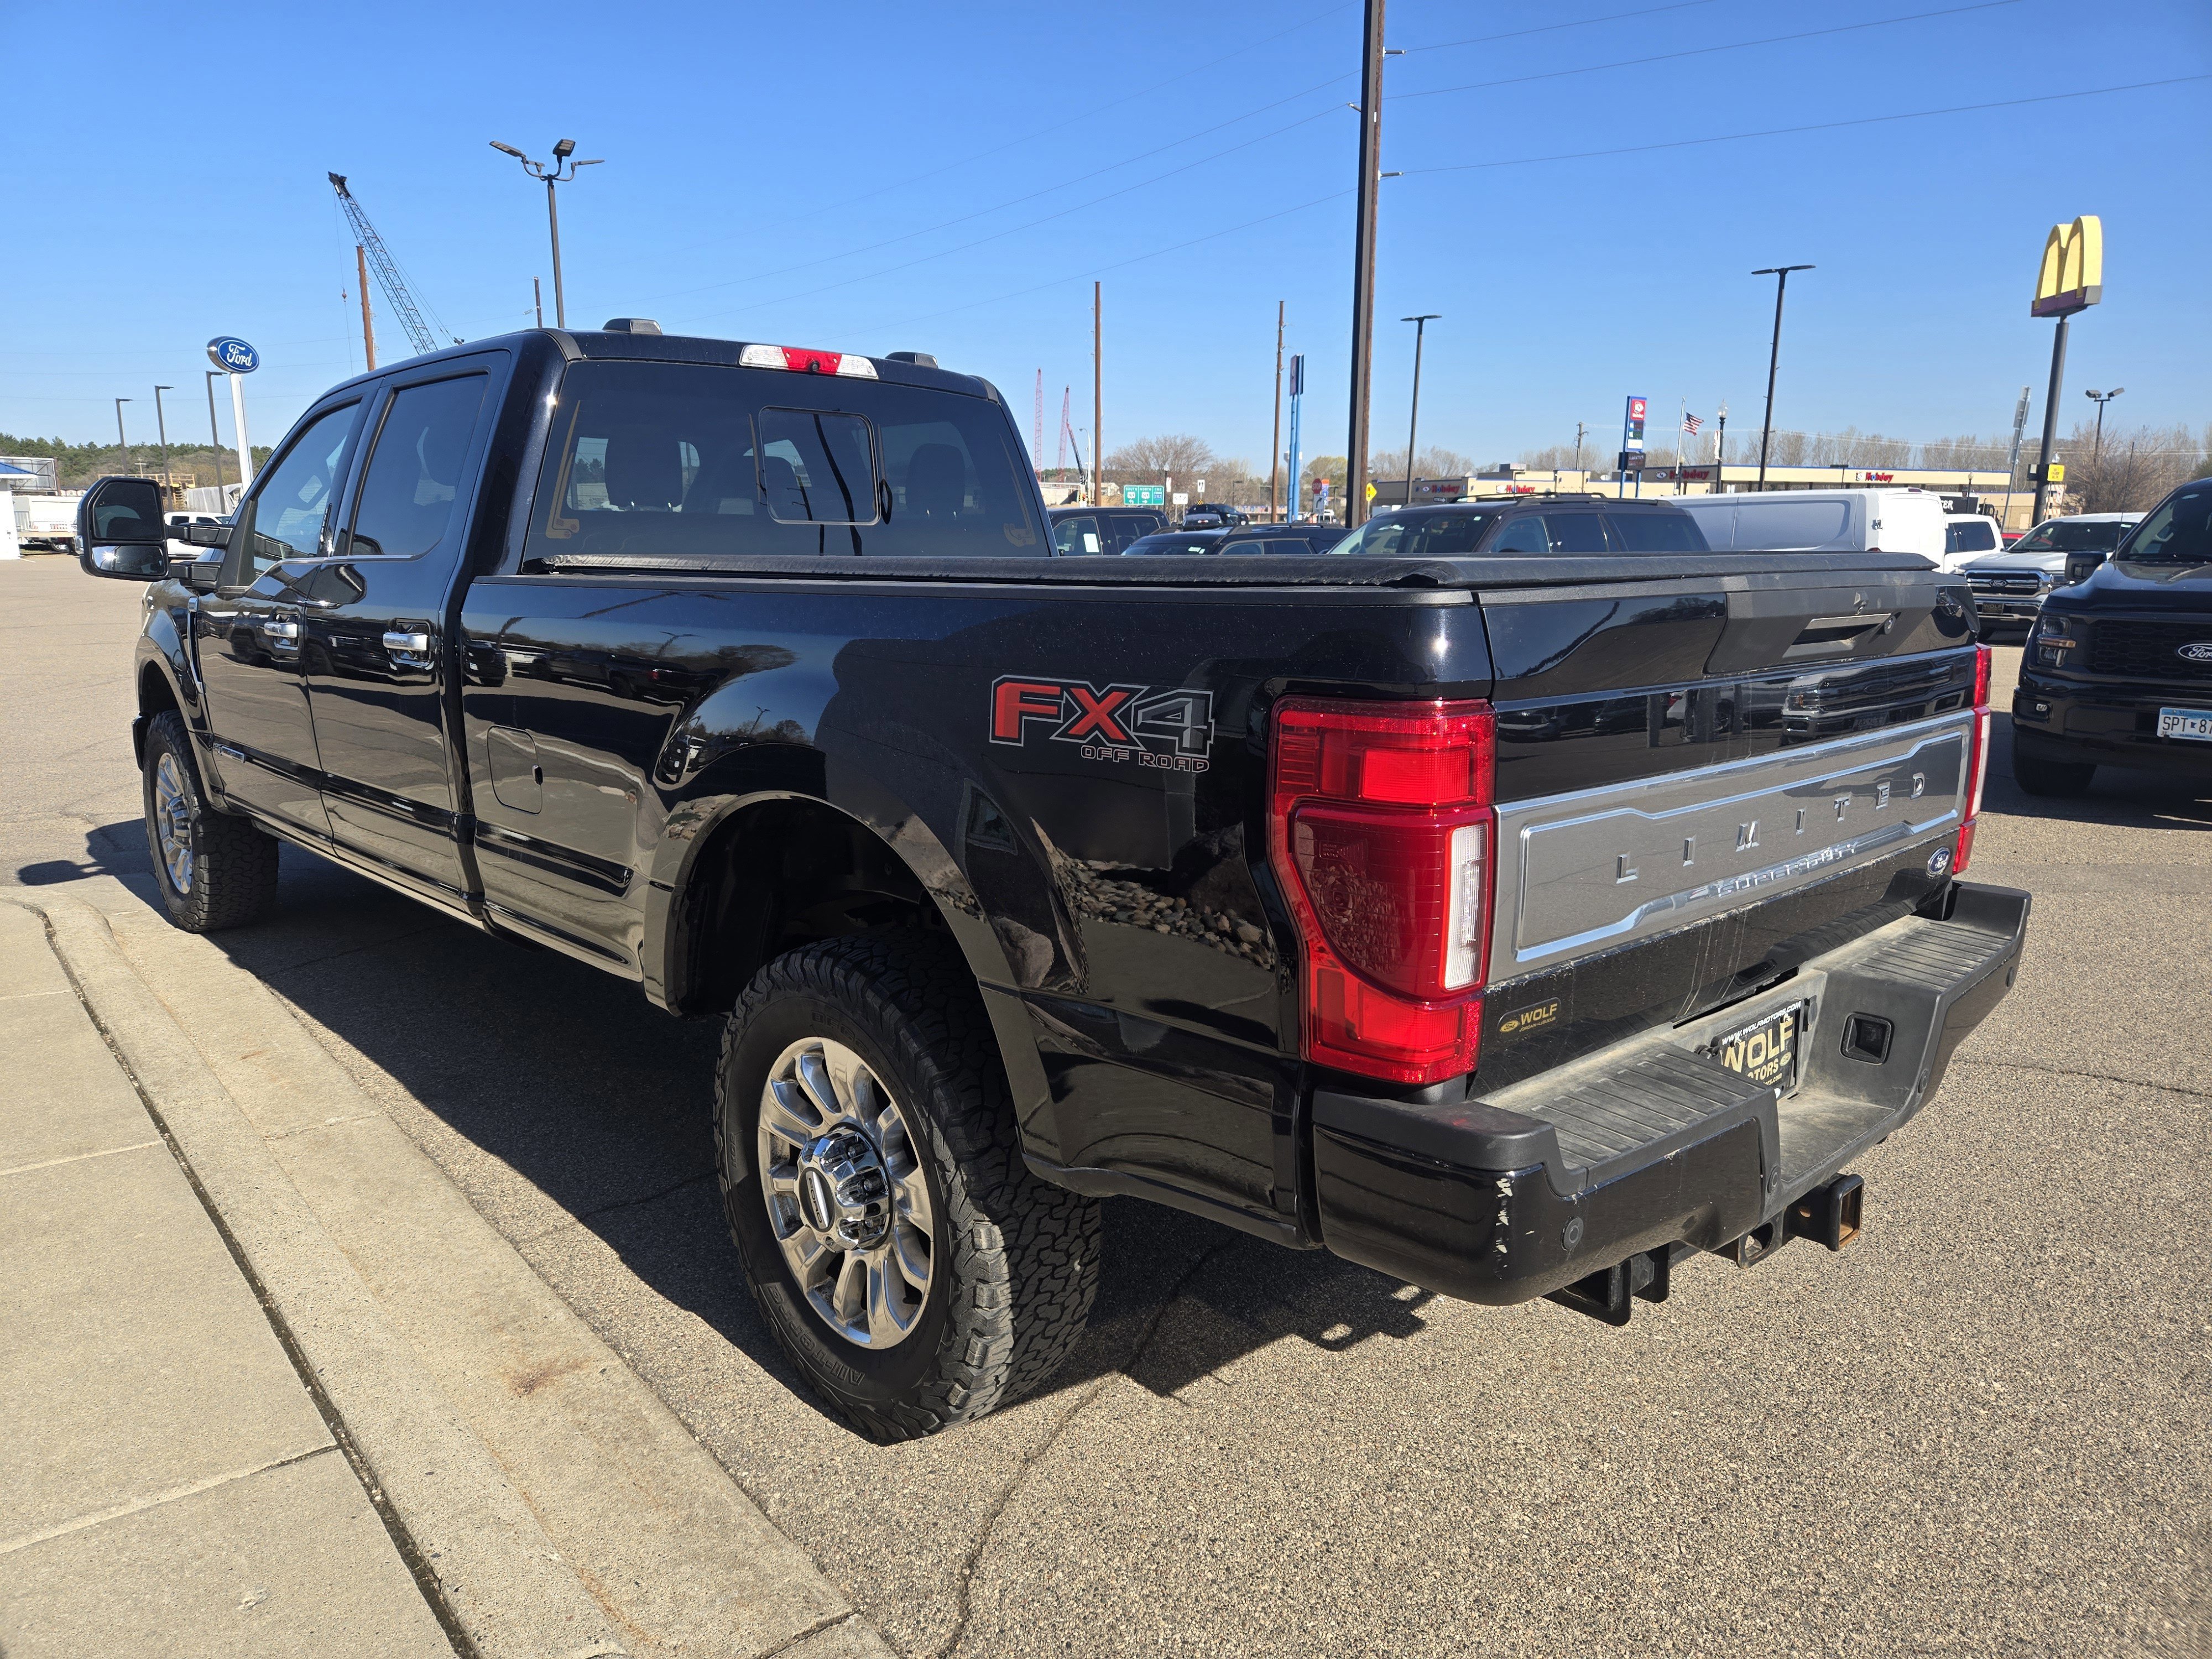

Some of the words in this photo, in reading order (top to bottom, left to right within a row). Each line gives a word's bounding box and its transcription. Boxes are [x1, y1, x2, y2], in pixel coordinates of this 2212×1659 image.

[227, 343, 252, 367] Ford
[1669, 469, 1710, 480] Hliday
[1312, 482, 1322, 491] STOP
[2188, 645, 2212, 658] For
[989, 674, 1214, 758] FX4
[2162, 716, 2189, 732] SPT
[1081, 745, 1129, 762] OFF
[1139, 752, 1209, 773] ROAD
[1616, 773, 1926, 884] LIMITED
[1521, 1003, 1558, 1025] WOLF
[808, 1177, 822, 1223] FORD
